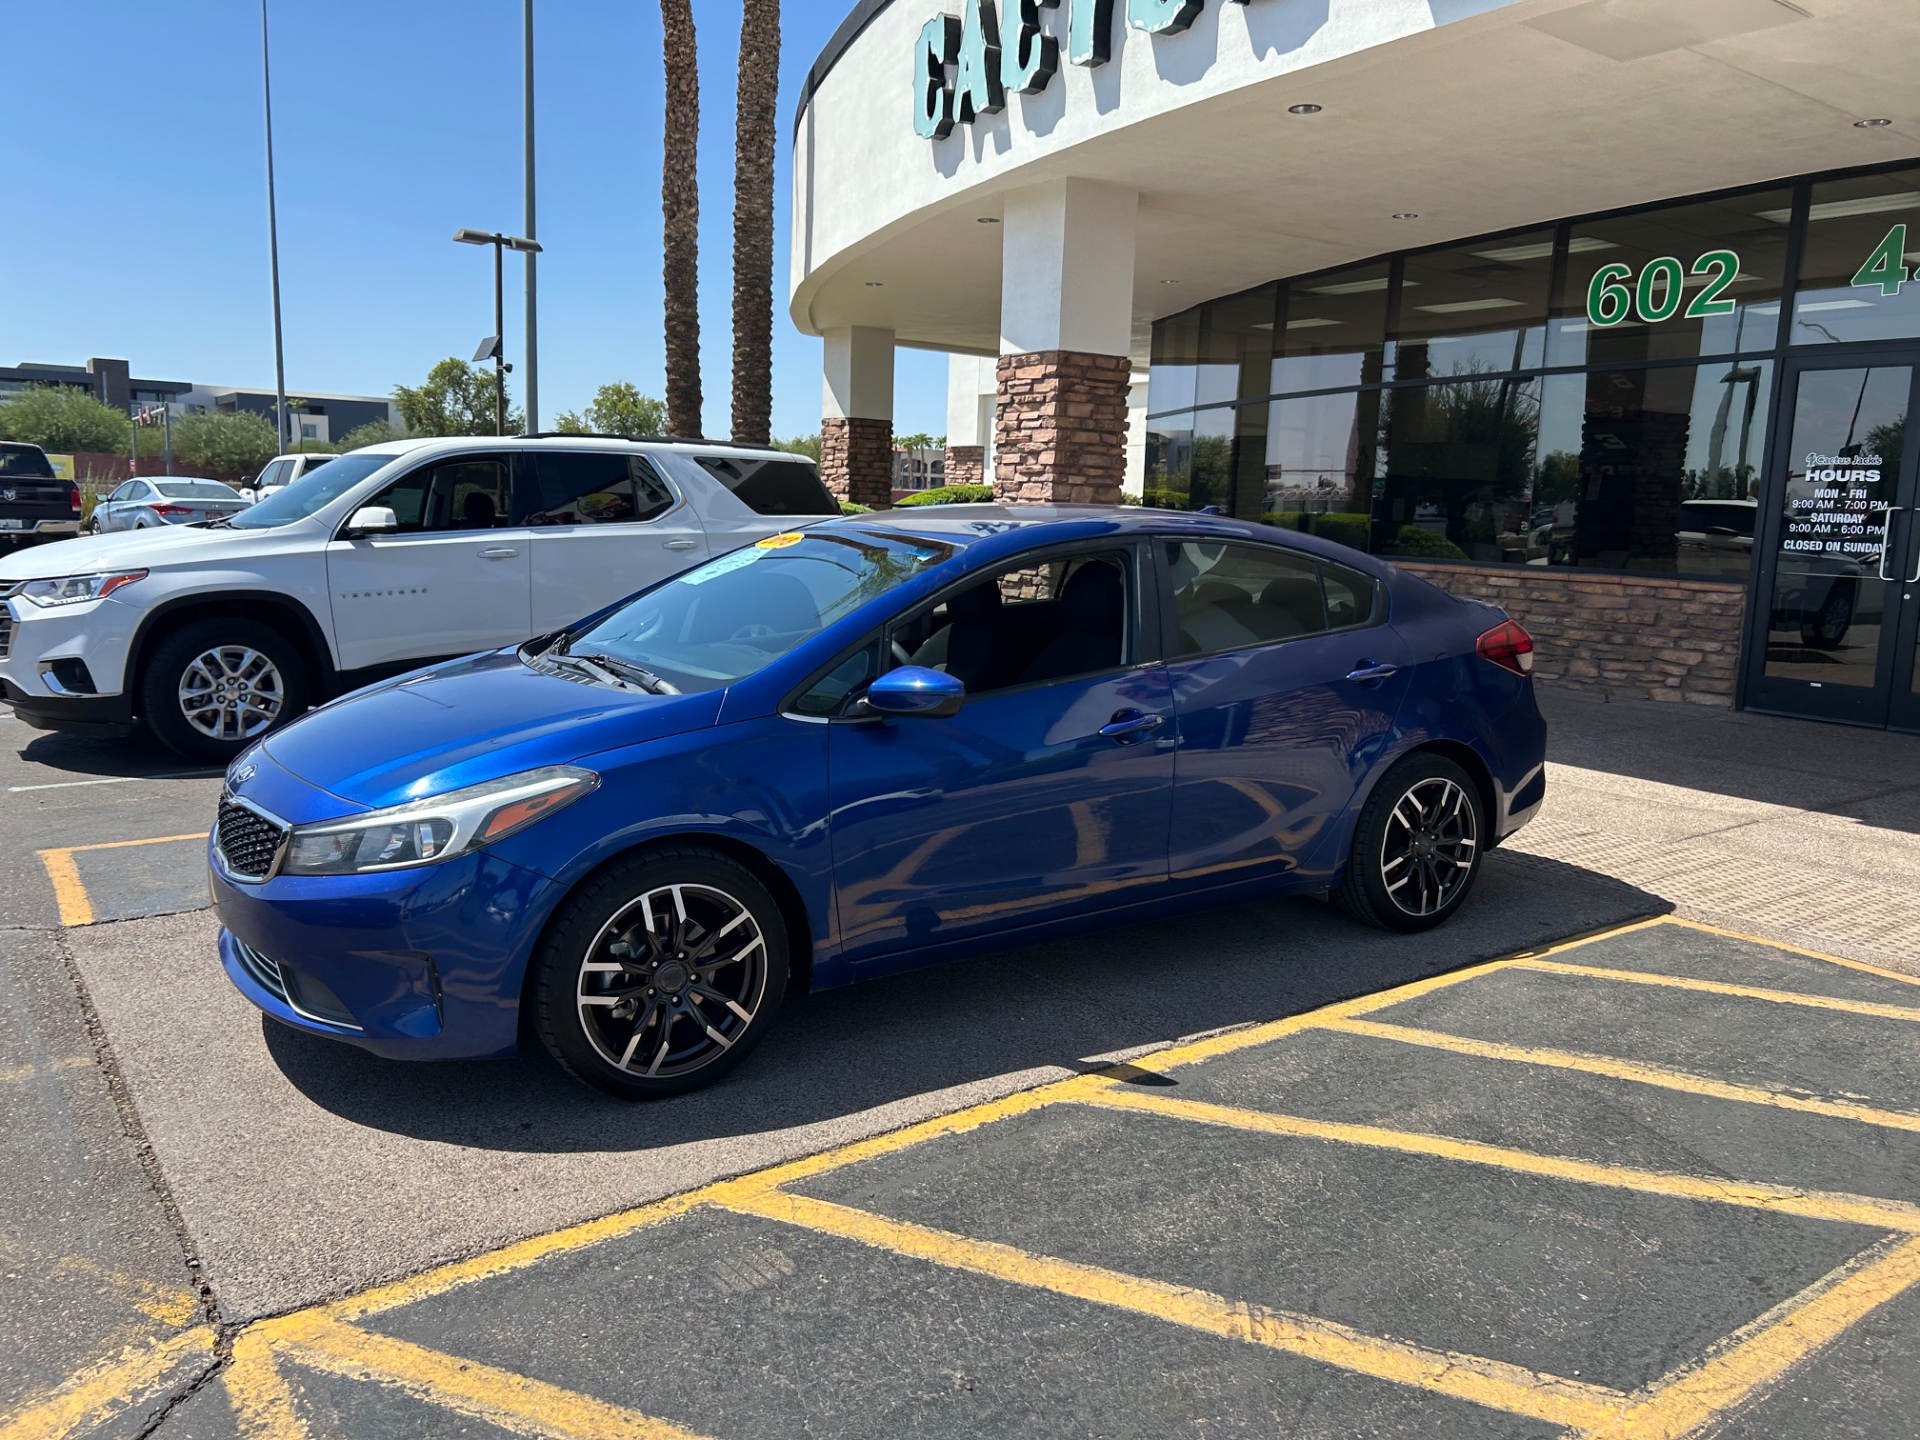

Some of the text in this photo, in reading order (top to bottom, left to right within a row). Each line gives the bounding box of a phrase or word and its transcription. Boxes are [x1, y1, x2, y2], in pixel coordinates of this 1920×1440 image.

[1587, 224, 1920, 326] 602 4
[1816, 454, 1851, 466] Cactus
[1805, 469, 1881, 482] HOURS
[1814, 489, 1839, 499] MON
[1849, 489, 1867, 499] FRI
[1792, 500, 1814, 509] 9:00
[1816, 500, 1834, 509] AM
[1844, 501, 1867, 510] 7:00
[1869, 501, 1888, 510] PM
[1810, 513, 1864, 524] SATURDAY
[1789, 524, 1811, 533] 9:00
[1813, 525, 1831, 534] AM
[1841, 526, 1864, 535] 6:00
[1866, 526, 1885, 535] PM
[1783, 540, 1823, 551] CLOSED
[1826, 542, 1841, 552] ON
